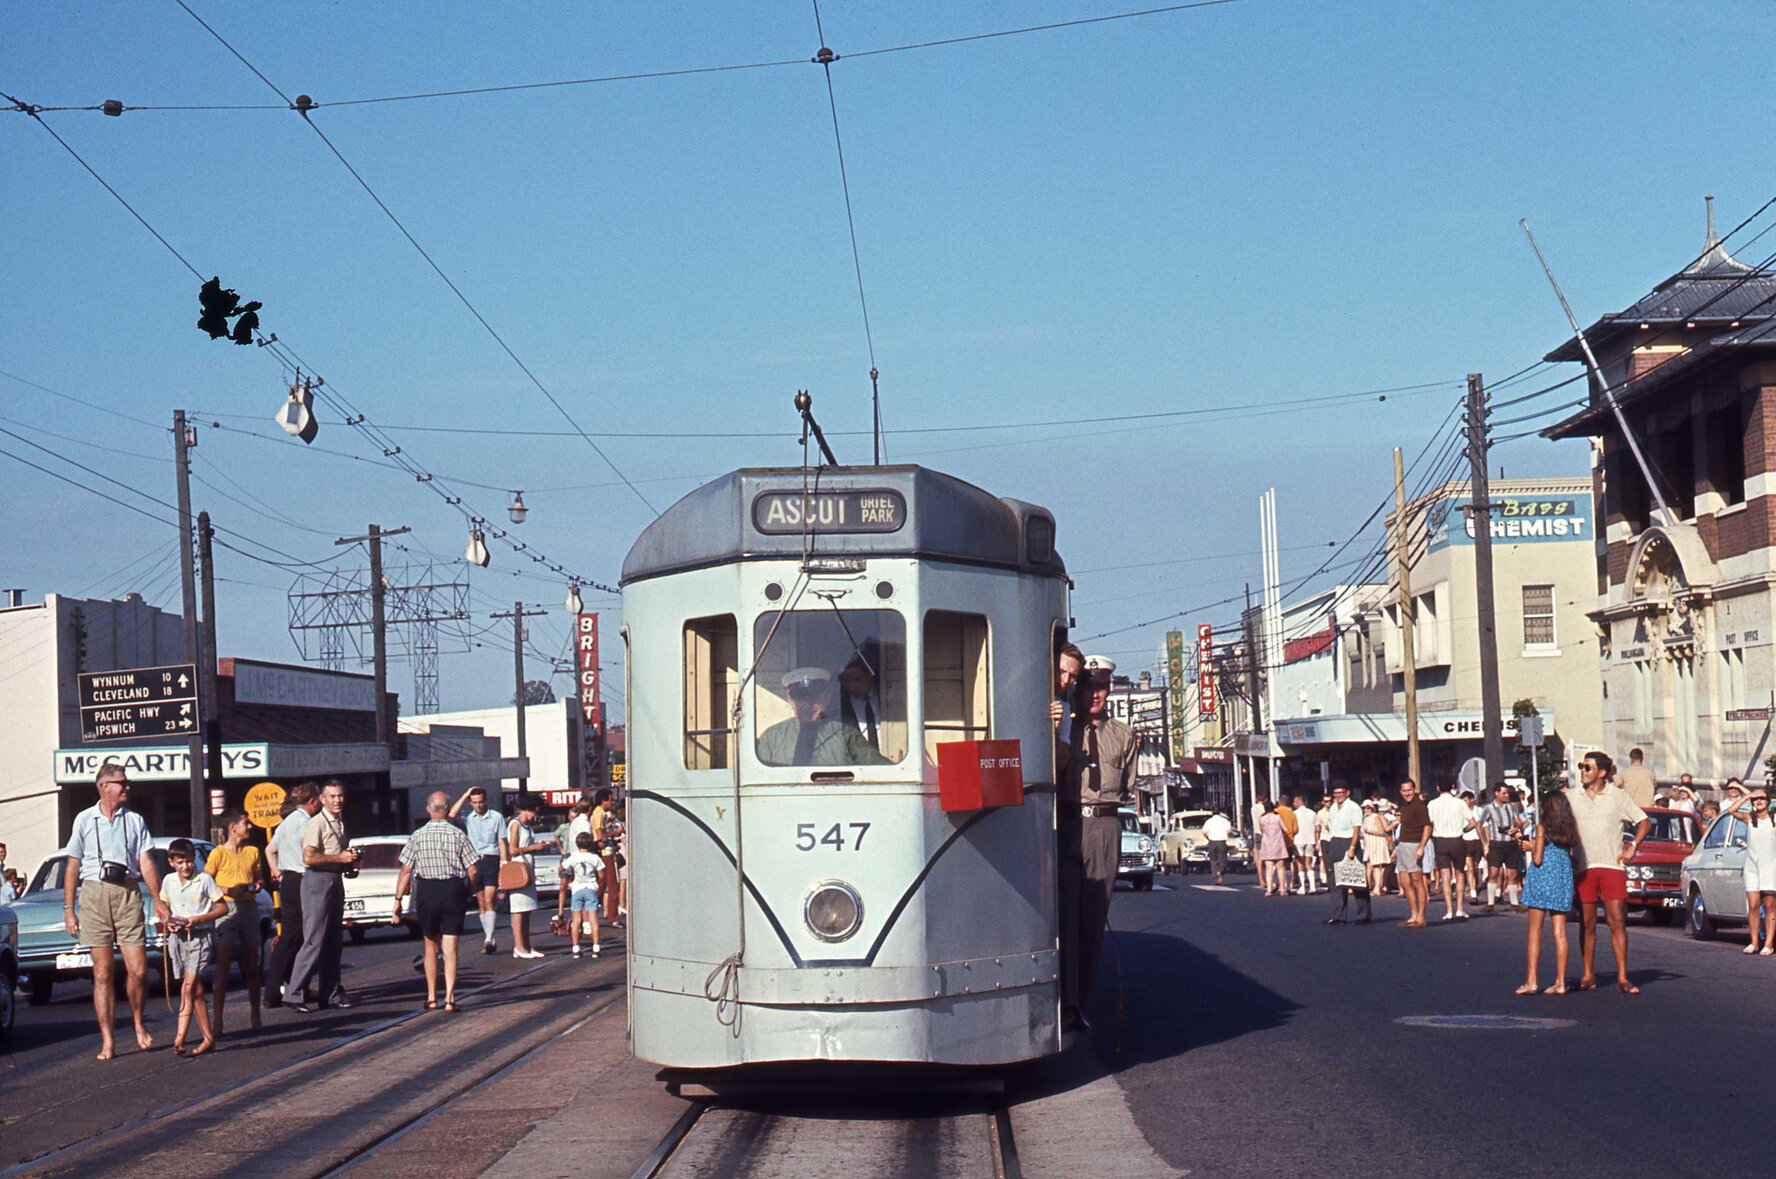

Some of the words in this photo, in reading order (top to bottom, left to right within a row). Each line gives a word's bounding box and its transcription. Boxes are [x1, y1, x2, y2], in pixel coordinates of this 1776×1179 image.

[767, 497, 848, 524] ASCOT
[861, 509, 894, 523] PARK
[1200, 626, 1213, 711] CHEMIST
[92, 674, 134, 688] WYNNUM
[162, 672, 172, 682] 10
[93, 687, 149, 702] CLEVELAND
[163, 686, 172, 696] 18
[94, 709, 132, 722] PACIFIC
[140, 707, 160, 719] HWY
[95, 722, 136, 736] IPSWICH
[165, 720, 176, 730] 23
[980, 758, 995, 769] POST
[999, 757, 1020, 768] OFFICE
[254, 792, 279, 801] WAIT
[796, 822, 871, 852] 547
